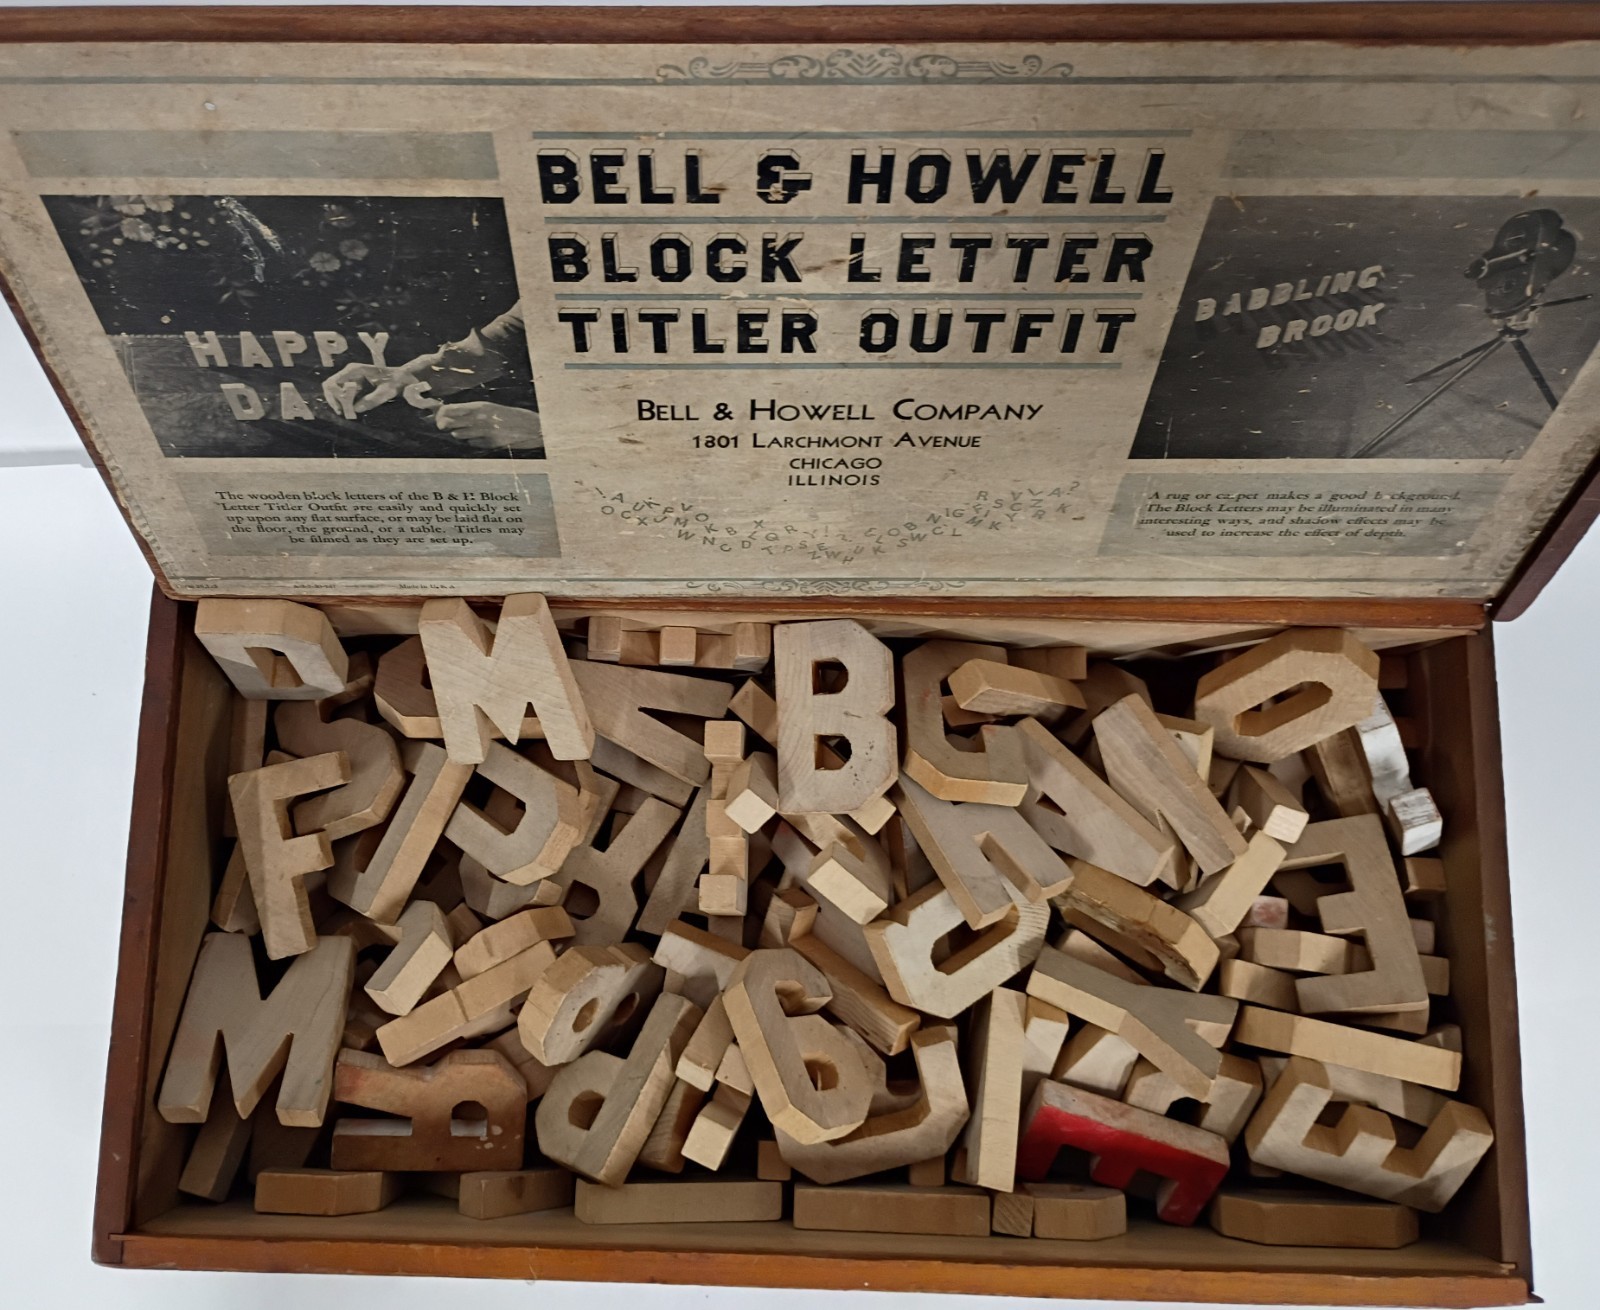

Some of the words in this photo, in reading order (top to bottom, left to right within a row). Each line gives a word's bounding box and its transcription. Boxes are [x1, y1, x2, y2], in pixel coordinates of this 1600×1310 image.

[536, 148, 721, 204] BELL
[756, 148, 813, 204] &
[847, 148, 1173, 204] HOWELL
[548, 232, 804, 283] BLOCK
[847, 232, 1154, 283] LETTER
[1195, 265, 1384, 322] BABBLING
[558, 307, 819, 353] TITLER
[859, 308, 1136, 353] OUTFIT
[1256, 303, 1386, 349] BROOK
[184, 331, 389, 367] HAPPY
[713, 402, 734, 421] &
[692, 435, 739, 448] 1801
[789, 457, 882, 469] CHICAGO
[788, 474, 880, 486] ILLINOIS
[215, 491, 243, 500] The
[248, 491, 300, 500] wooden
[345, 492, 386, 501] letters
[389, 492, 403, 501] of
[408, 492, 429, 500] the
[432, 492, 443, 500] B
[480, 492, 519, 501] Block
[1148, 491, 1160, 500] A
[1165, 493, 1191, 502] rug
[1266, 491, 1310, 500] makes
[1328, 491, 1368, 502] good
[220, 503, 260, 511] Letter
[264, 503, 302, 511] Titler
[308, 503, 348, 511] Outfit
[378, 503, 413, 514] easily
[420, 503, 444, 512] and
[449, 503, 498, 514] quickly
[1146, 504, 1173, 512] The
[1174, 504, 1213, 512] Block
[1216, 504, 1263, 512] Letters
[1265, 506, 1295, 514] may
[1298, 504, 1315, 512] be
[1317, 504, 1398, 513] illuminated
[1400, 504, 1413, 512] in
[1416, 506, 1455, 515] many
[226, 515, 243, 524] up
[247, 515, 281, 524] upon
[285, 516, 307, 524] any
[311, 514, 332, 522] flat
[334, 514, 385, 523] surface,
[406, 516, 433, 525] may
[436, 515, 451, 523] be
[455, 515, 479, 523] laid
[482, 515, 503, 523] flat
[1138, 517, 1212, 527] interesting
[1217, 518, 1253, 527] ways,
[1258, 516, 1286, 524] and
[1289, 517, 1341, 525] shadow
[1346, 517, 1389, 525] effects
[1393, 519, 1423, 527] may
[1429, 517, 1447, 525] be
[232, 525, 251, 533] the
[257, 525, 292, 534] floor,
[296, 525, 317, 533] the
[322, 525, 374, 535] ground,
[410, 525, 446, 533] table.
[453, 525, 492, 534] Titles
[498, 527, 525, 535] may
[1220, 529, 1274, 537] increase
[1278, 529, 1300, 537] the
[1304, 529, 1340, 537] effect
[1345, 529, 1363, 537] of
[1364, 529, 1406, 539] depth.
[289, 535, 305, 543] be
[310, 535, 350, 543] filmed
[373, 535, 400, 545] they
[452, 537, 474, 546] up.
[773, 618, 898, 815] B
